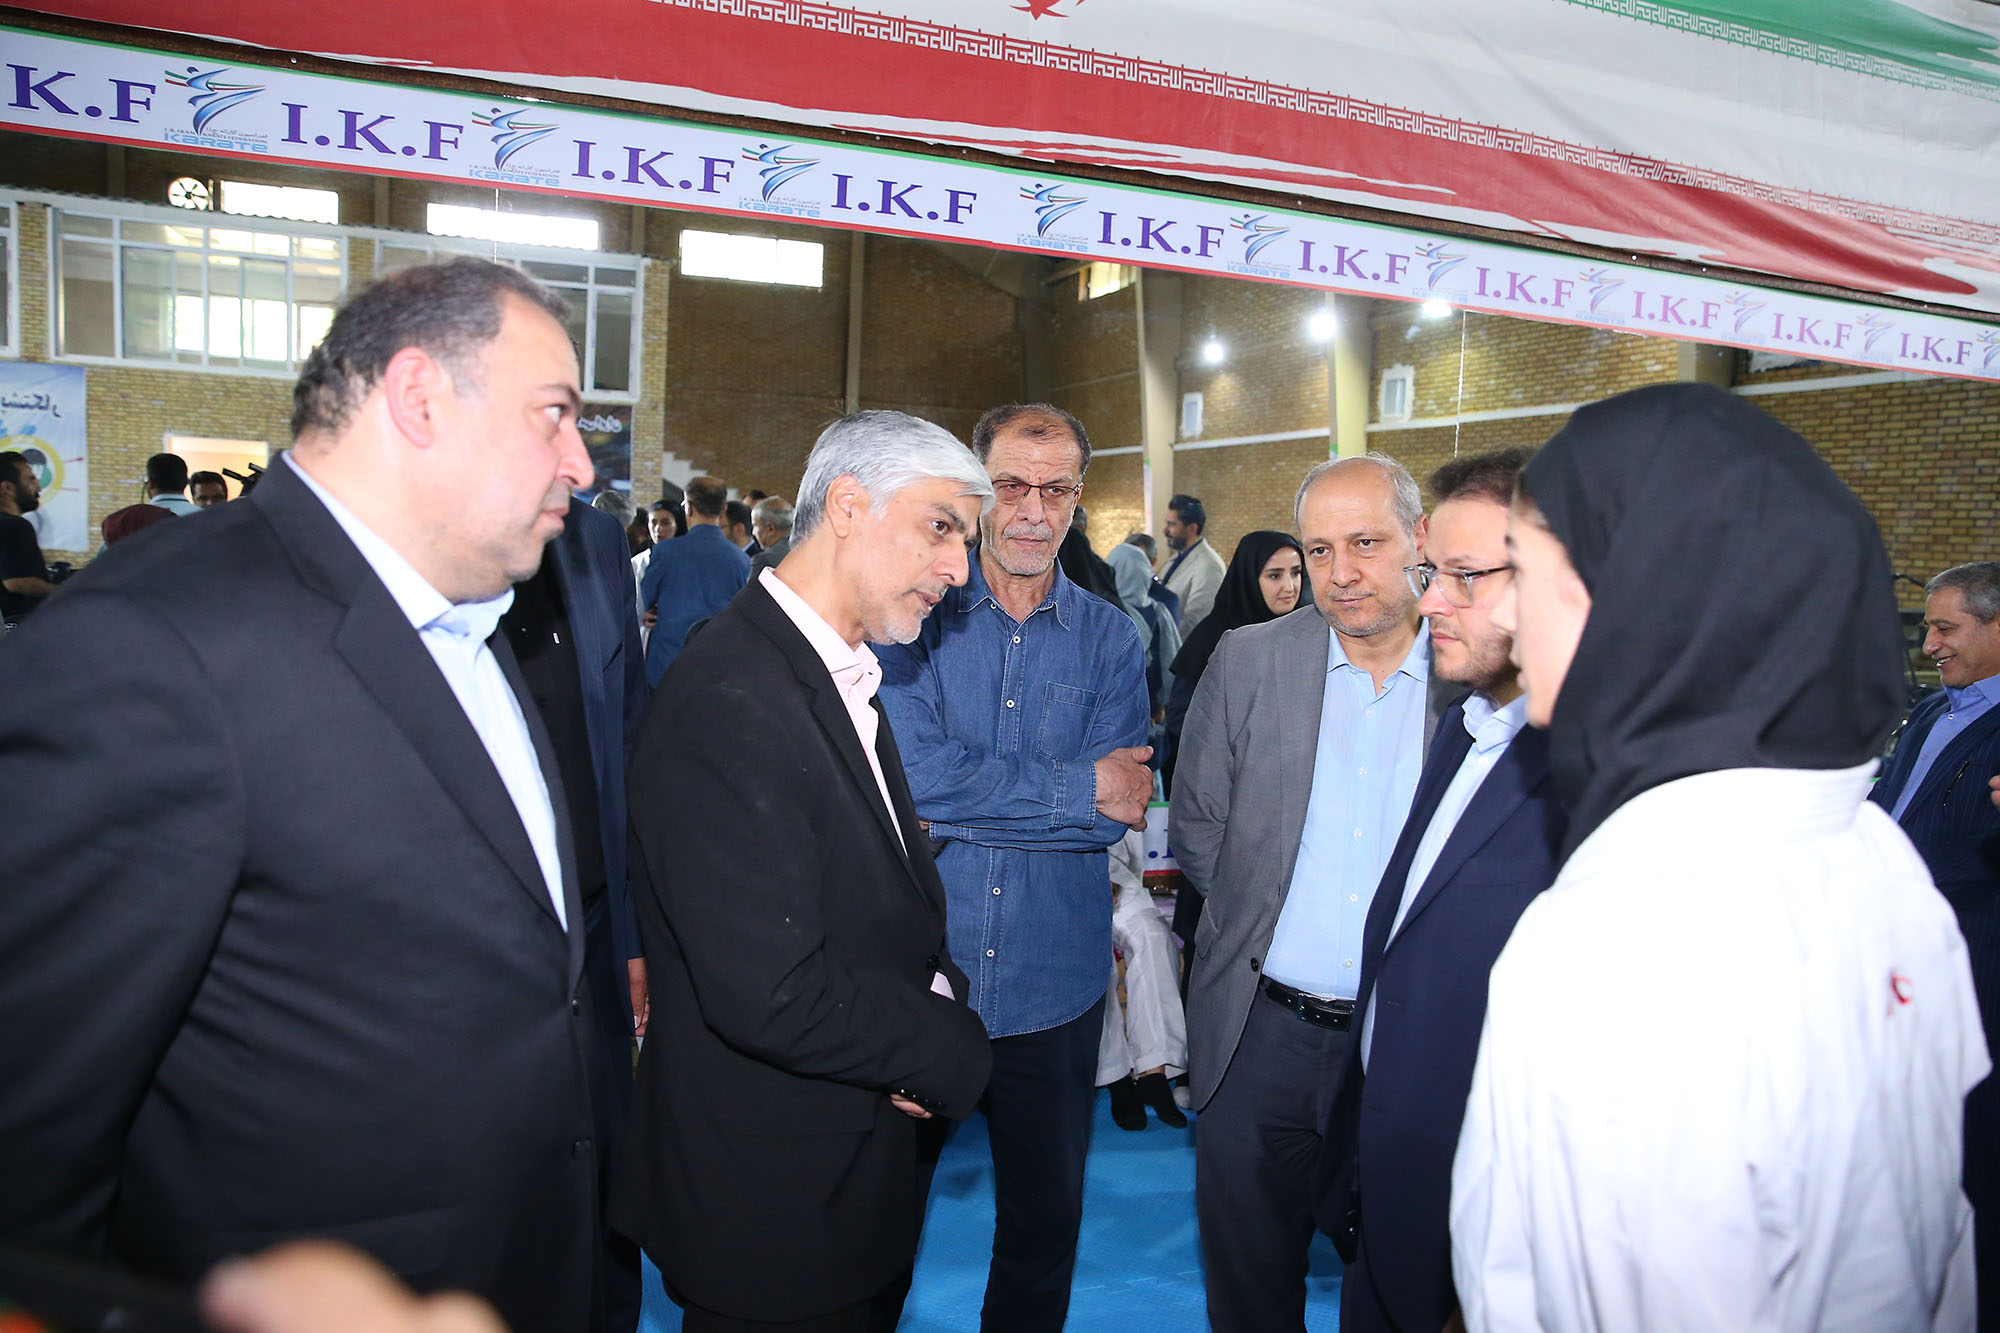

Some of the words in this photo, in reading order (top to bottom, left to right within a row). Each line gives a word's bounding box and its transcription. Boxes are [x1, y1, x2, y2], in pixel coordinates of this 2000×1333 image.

[5, 63, 156, 124] K.F
[281, 102, 464, 162] I.K.F
[571, 140, 735, 195] I.K.F
[831, 173, 977, 225] I.K.F
[1097, 211, 1225, 258] I.K.F
[1298, 240, 1410, 284] I.K.F
[1475, 267, 1574, 307] I.K.F
[1632, 291, 1720, 329] I.K.F
[1772, 313, 1852, 348] I.K.F
[1898, 333, 1973, 365] I.K.F
